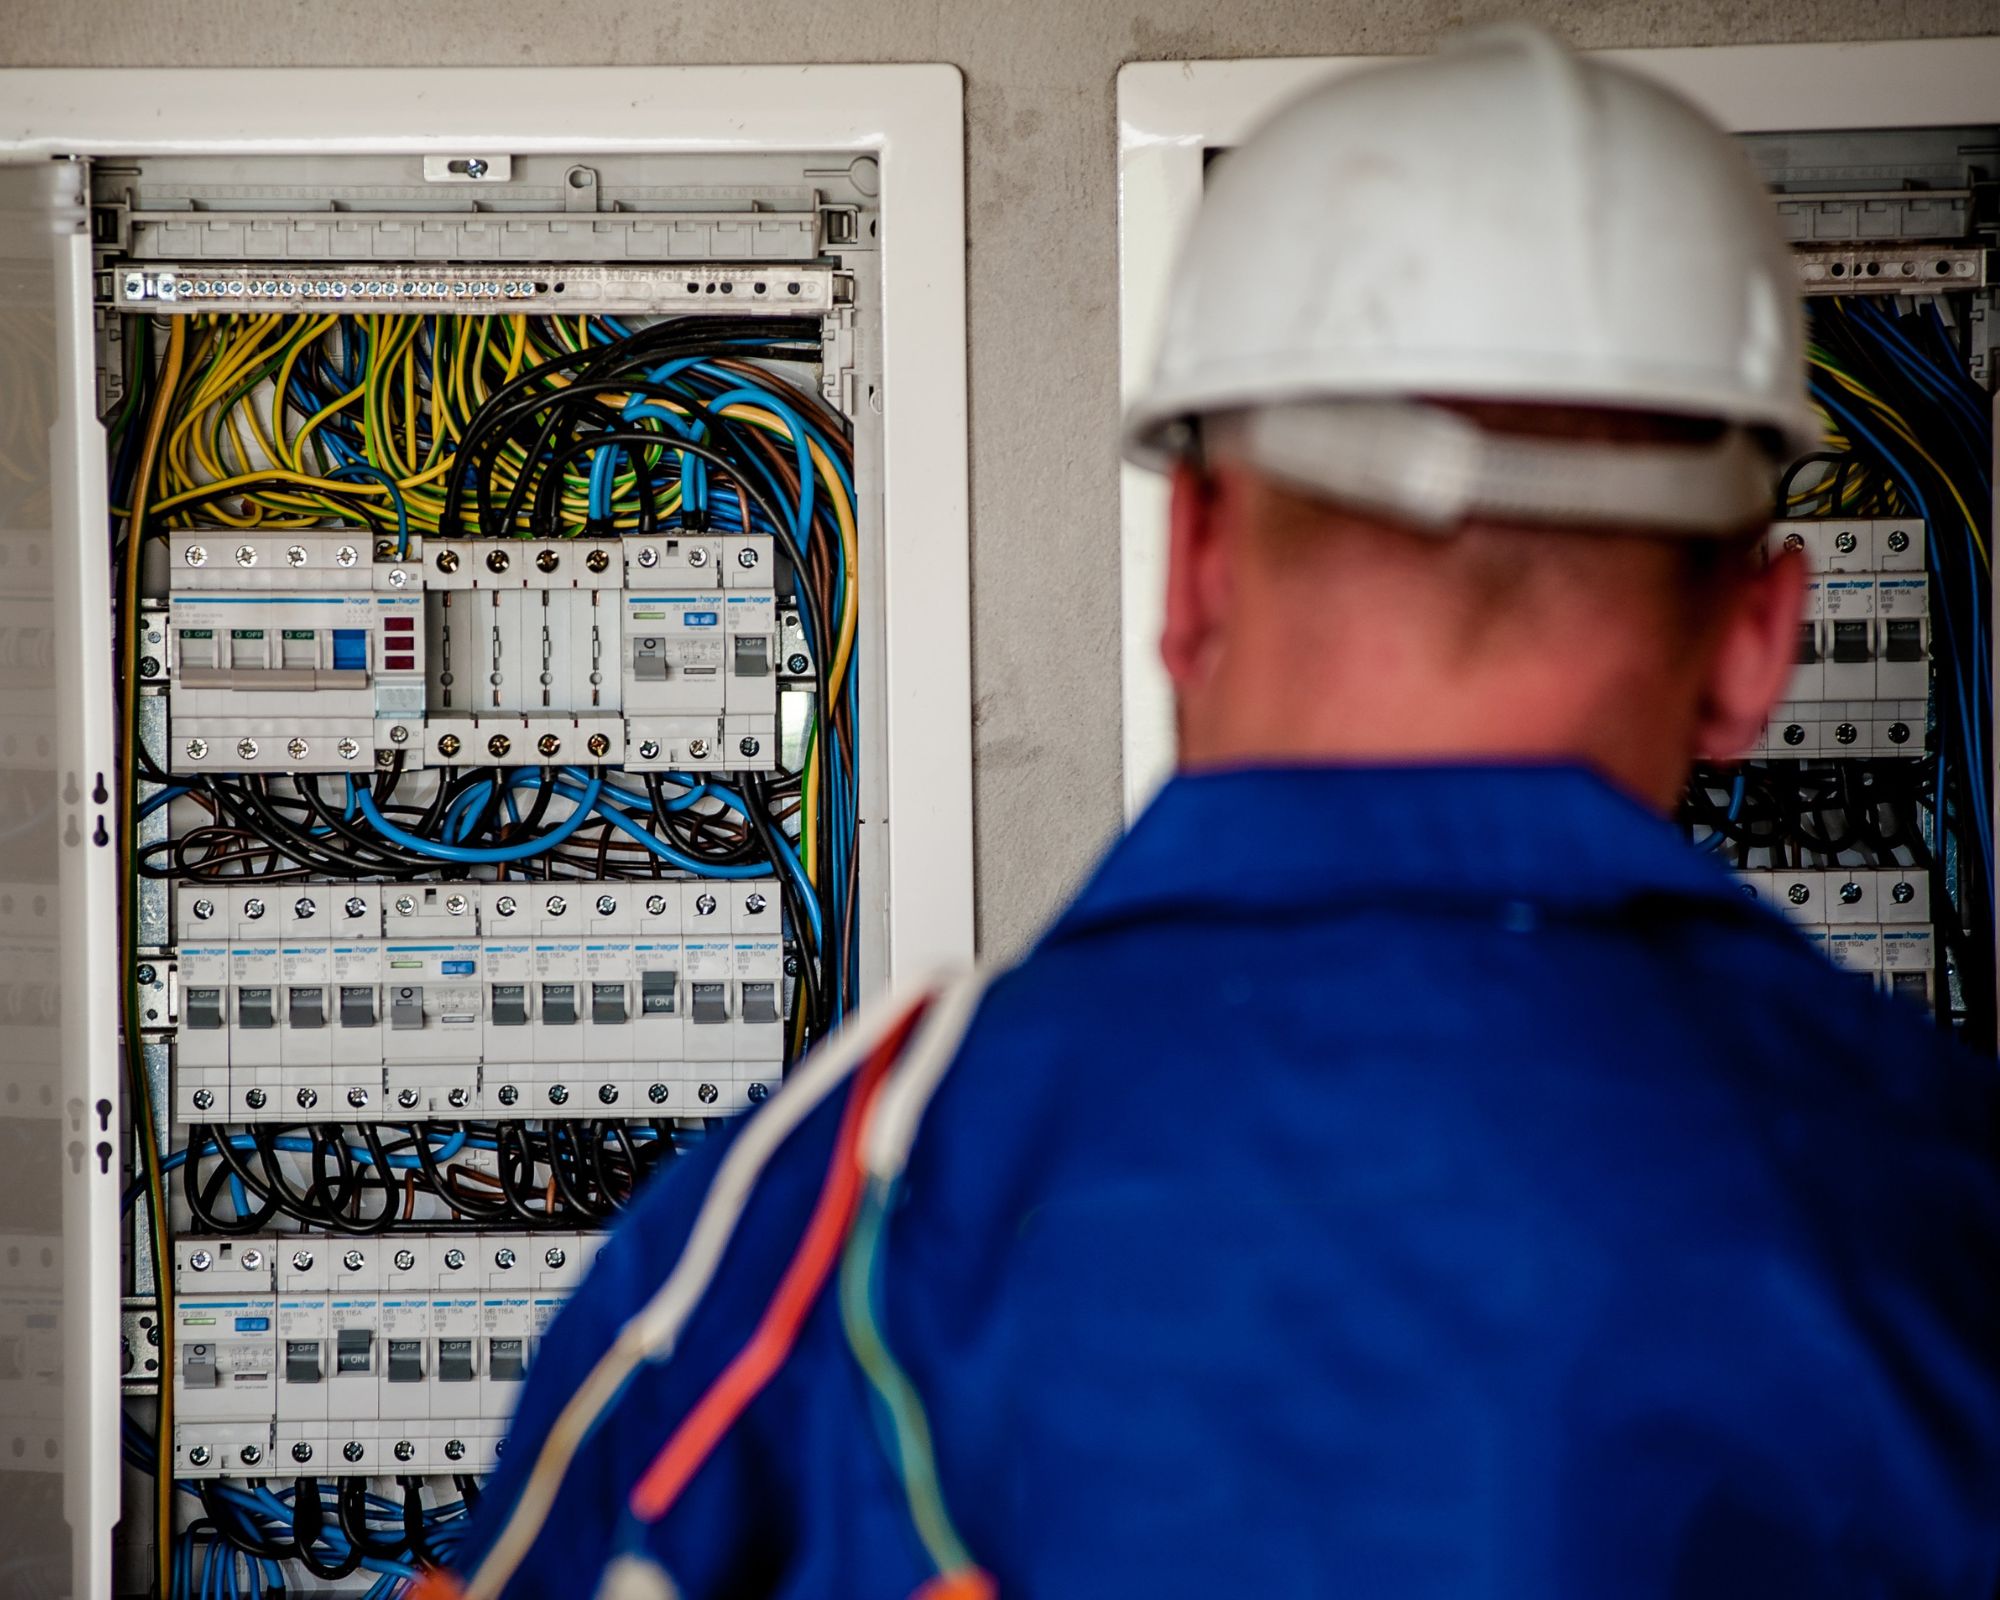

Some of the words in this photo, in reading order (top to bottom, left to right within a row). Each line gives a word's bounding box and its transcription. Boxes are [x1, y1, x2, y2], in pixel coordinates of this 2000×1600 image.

[1850, 580, 1874, 589] hager
[1902, 579, 1926, 588] hager
[699, 595, 722, 603] hager
[748, 595, 772, 604] hager
[1853, 931, 1877, 941] hager
[1907, 931, 1930, 940] hager
[304, 945, 327, 955] hager
[356, 944, 379, 954] hager
[456, 943, 480, 952] hager
[506, 944, 529, 953] hager
[557, 943, 580, 953] hager
[607, 943, 631, 952] hager
[656, 942, 679, 951] hager
[706, 942, 730, 951] hager
[755, 941, 779, 951] hager
[204, 947, 227, 956] hager
[254, 947, 277, 956] hager
[655, 998, 669, 1006] ON
[251, 1299, 275, 1308] hager
[301, 1300, 325, 1309] hager
[353, 1299, 376, 1309] hager
[404, 1298, 428, 1308] hager
[454, 1298, 477, 1308] hager
[505, 1297, 529, 1307] hager
[450, 1342, 467, 1350] OFF
[350, 1356, 365, 1364] ON
